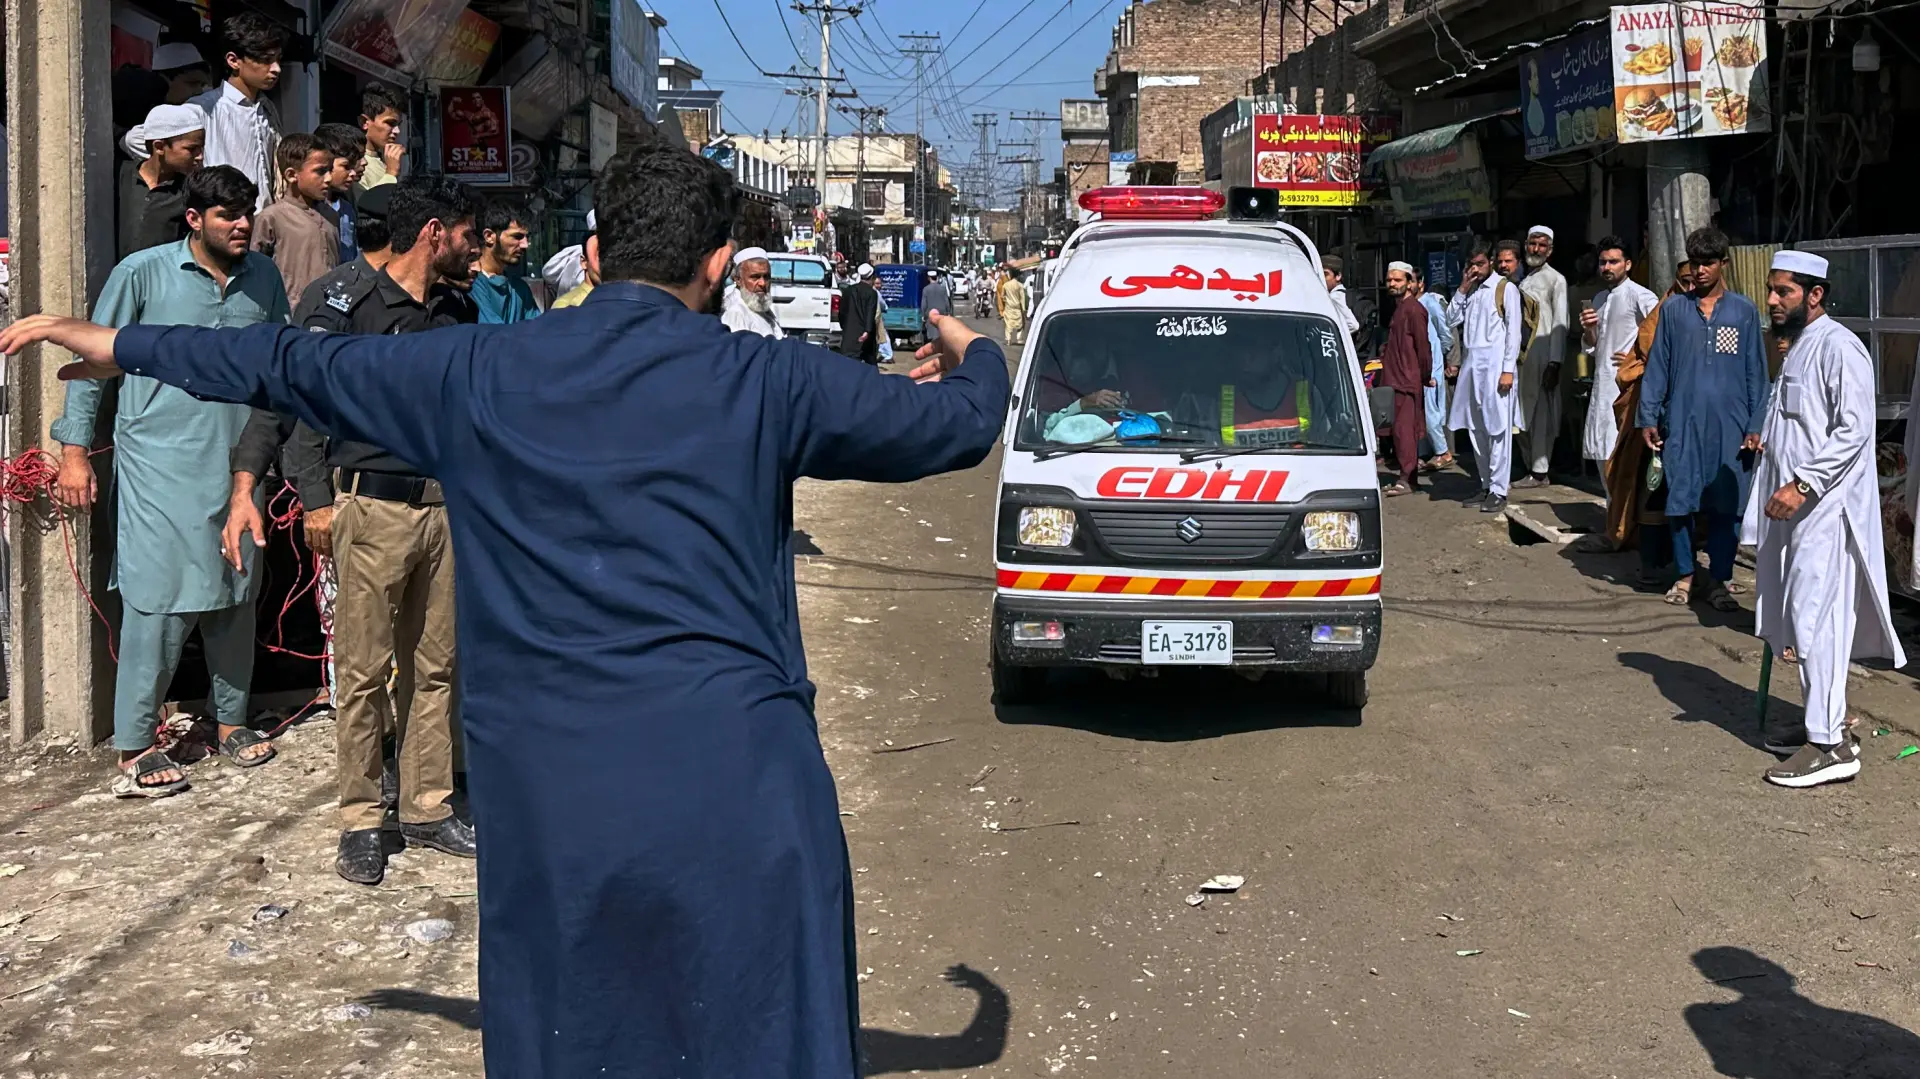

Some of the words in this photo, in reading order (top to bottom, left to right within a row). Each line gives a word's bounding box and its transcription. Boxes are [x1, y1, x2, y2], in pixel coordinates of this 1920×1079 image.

[1617, 11, 1675, 32] ANAYA
[1279, 194, 1319, 203] 9-5932793
[1100, 265, 1283, 302] ایدھی
[1097, 466, 1290, 502] EDHI
[1149, 633, 1227, 652] EA-3178
